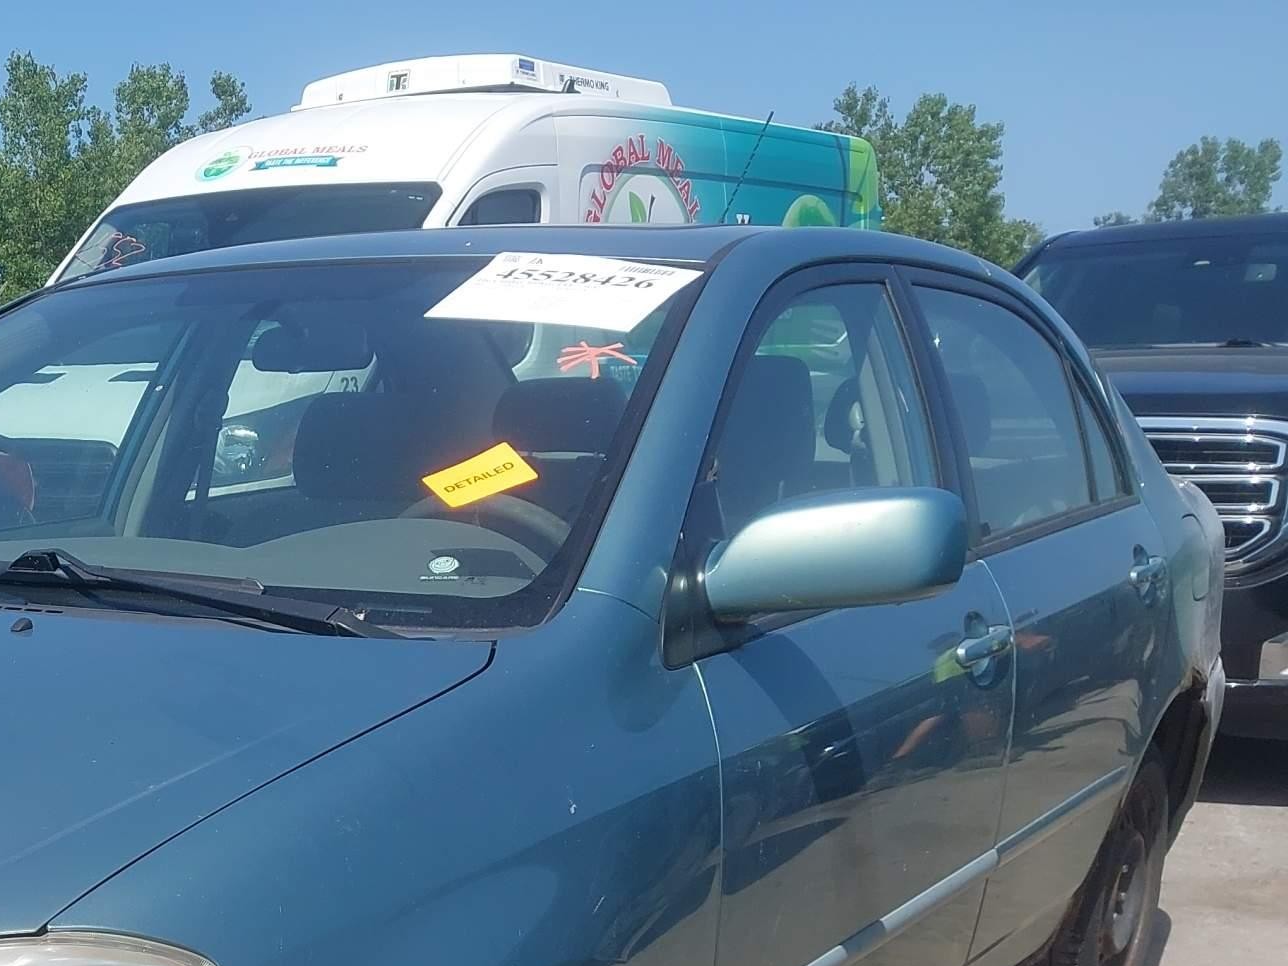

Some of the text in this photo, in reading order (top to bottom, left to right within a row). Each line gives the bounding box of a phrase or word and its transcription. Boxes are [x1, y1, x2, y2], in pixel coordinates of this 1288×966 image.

[594, 79, 609, 91] KING
[248, 144, 368, 160] GLOBAL MEALS
[656, 137, 700, 223] MEAL
[496, 267, 655, 289] 45528426
[340, 376, 359, 392] 23
[443, 461, 515, 494] DETAILED
